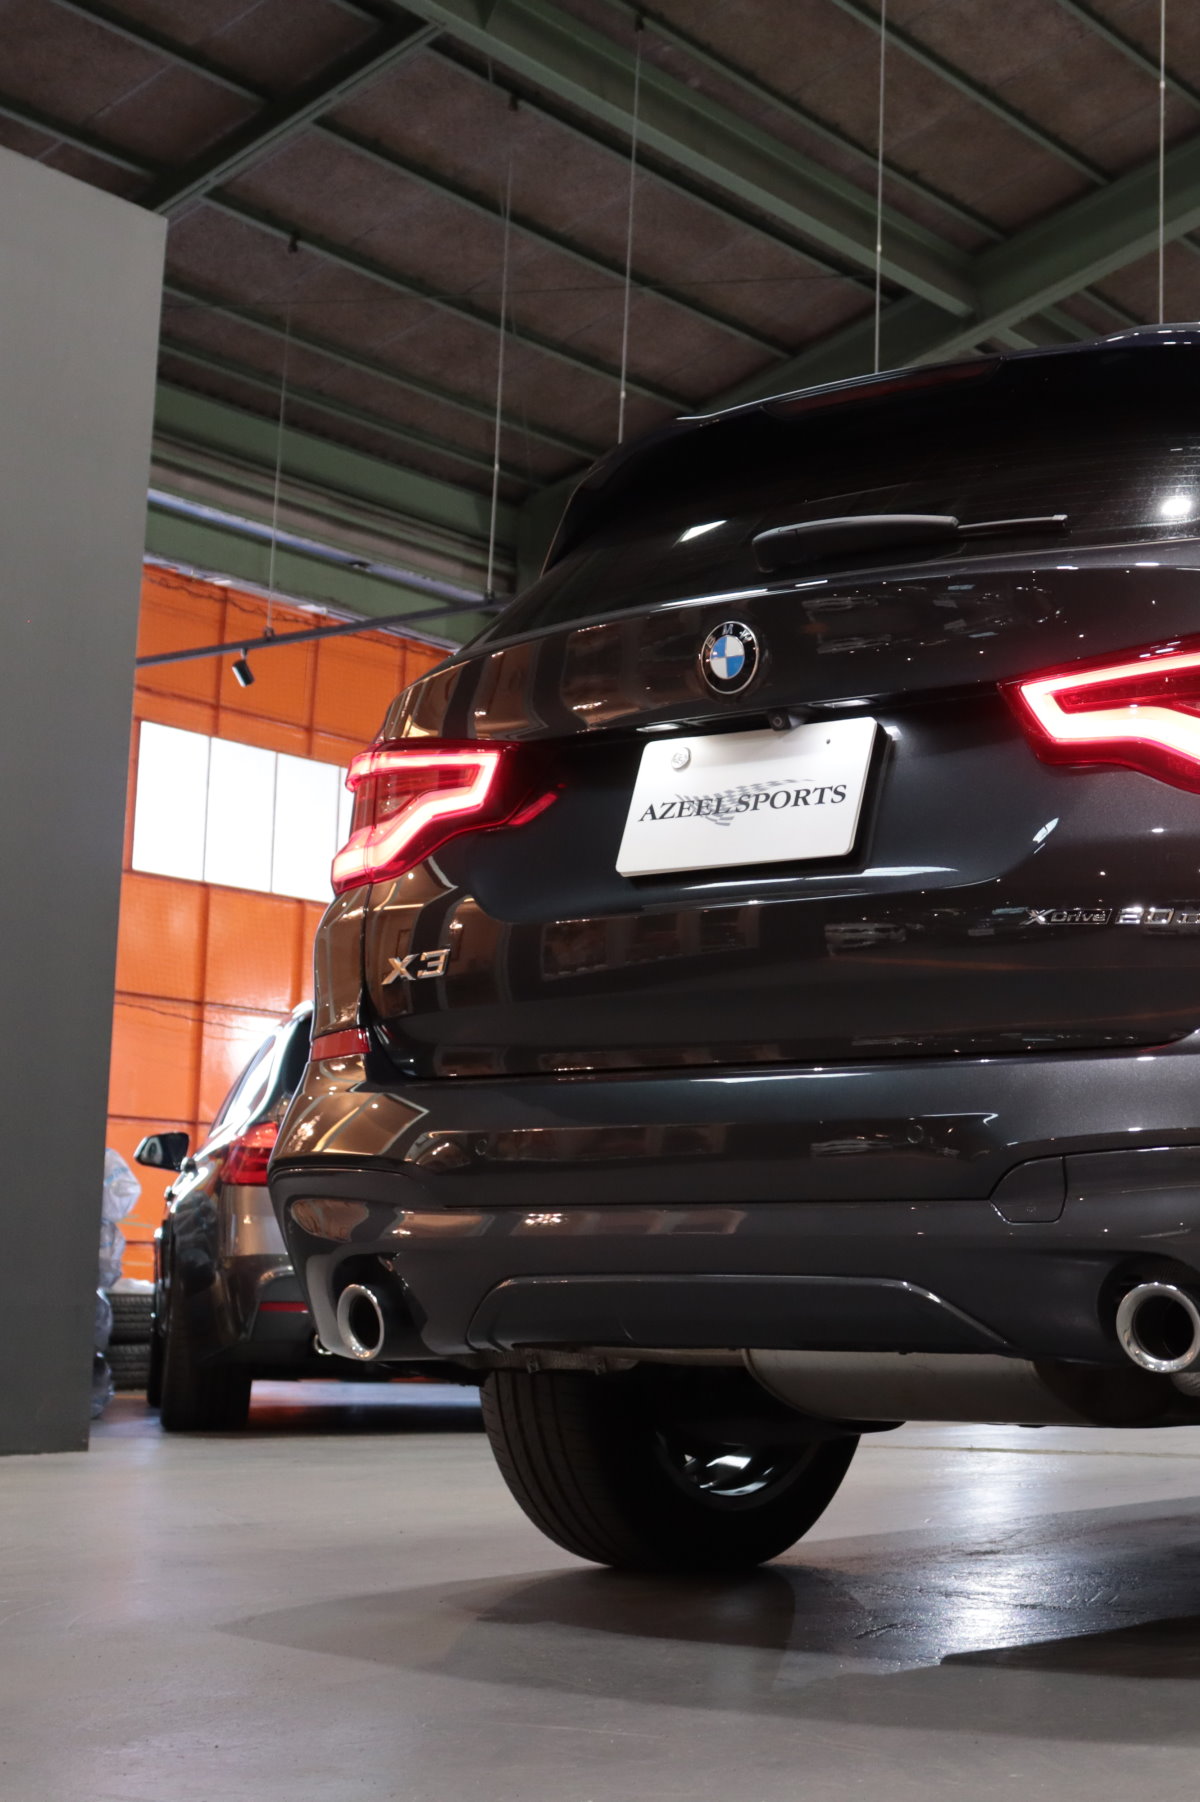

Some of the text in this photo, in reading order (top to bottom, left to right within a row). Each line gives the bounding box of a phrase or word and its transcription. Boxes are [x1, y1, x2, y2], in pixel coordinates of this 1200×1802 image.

[638, 784, 848, 822] AZEEL SPORTS
[381, 948, 451, 985] X3
